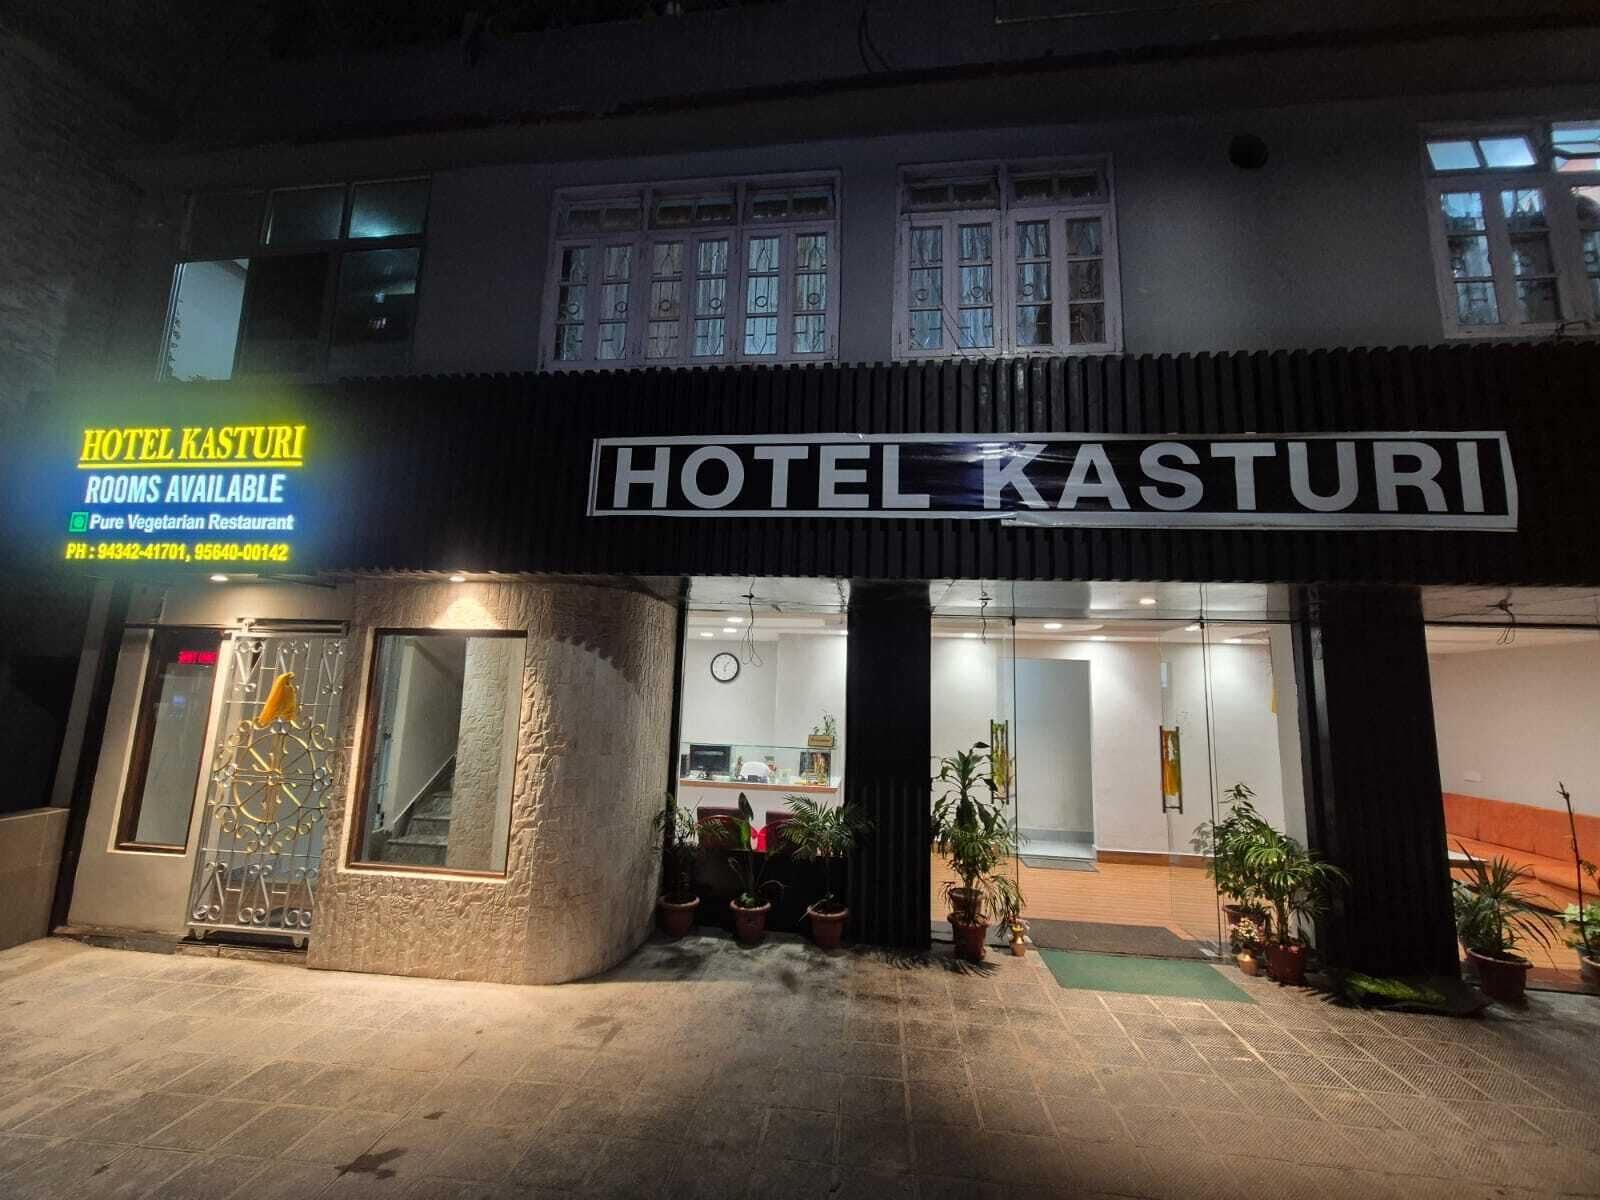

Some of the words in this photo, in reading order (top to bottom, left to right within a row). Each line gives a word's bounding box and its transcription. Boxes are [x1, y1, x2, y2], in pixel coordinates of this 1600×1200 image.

[80, 428, 175, 461] HOTEL
[178, 425, 306, 459] KASTURI
[85, 475, 162, 503] ROOMS
[164, 474, 286, 503] AVAILABLE
[612, 445, 931, 510] HOTEL
[982, 441, 1486, 513] KASTURI
[89, 513, 124, 530] Pure
[127, 514, 204, 533] Vegetarian
[208, 513, 294, 530] Restaurant
[97, 543, 190, 562] 94342-41701,
[194, 544, 288, 561] 95640-00142
